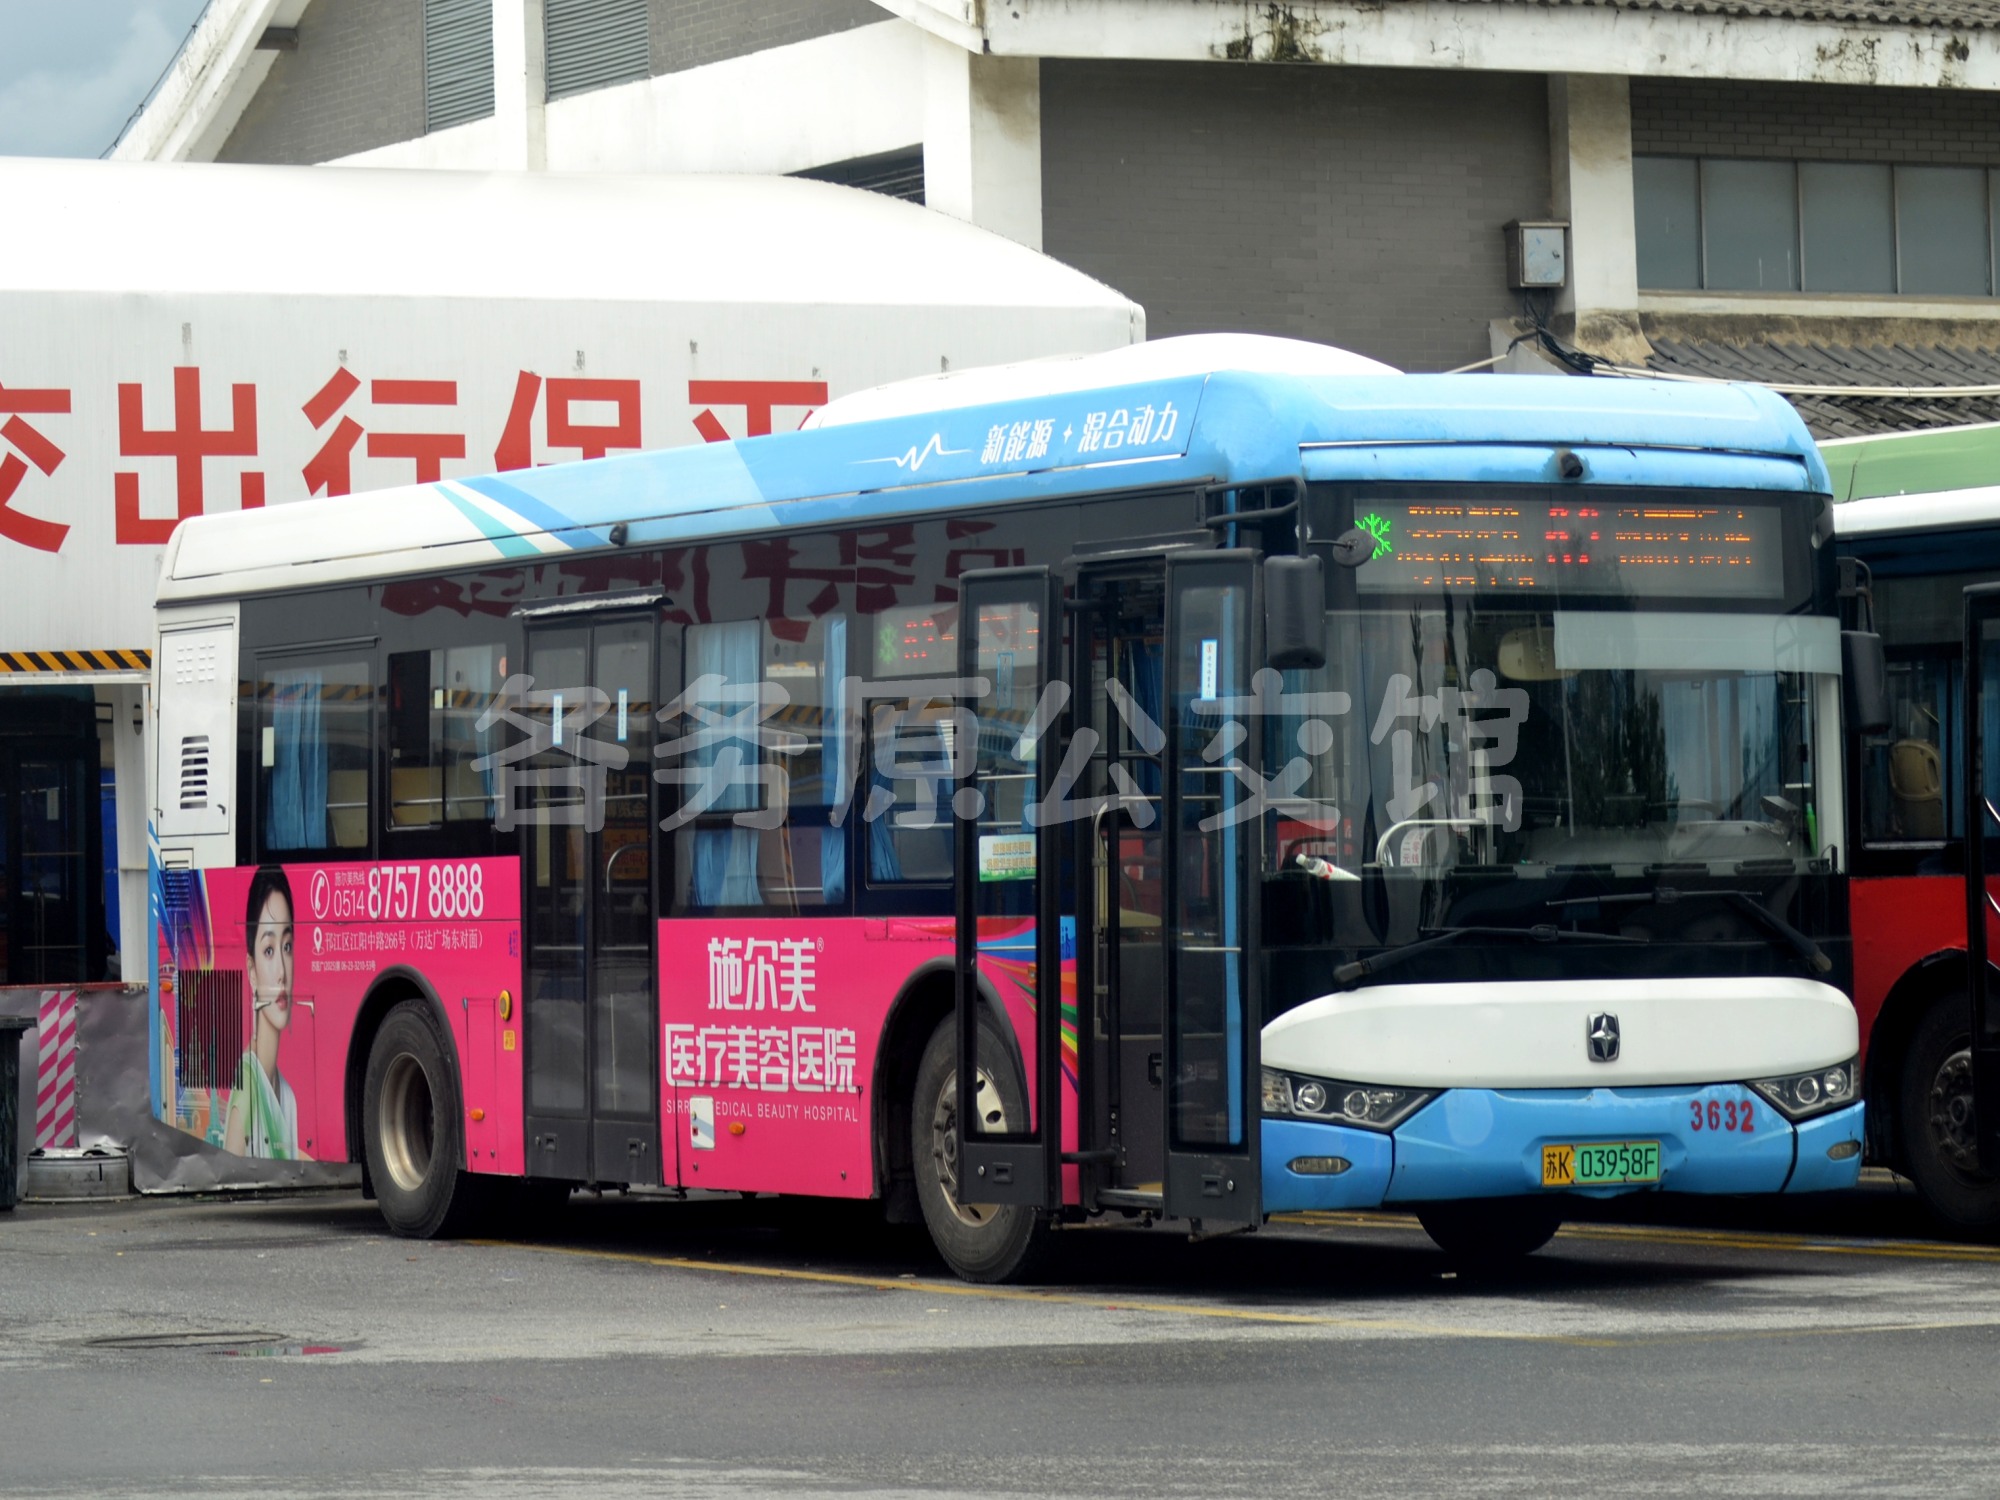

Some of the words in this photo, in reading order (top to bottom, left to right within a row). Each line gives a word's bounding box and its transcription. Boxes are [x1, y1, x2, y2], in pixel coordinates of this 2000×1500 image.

[980, 418, 1055, 465] 新能源
[1077, 401, 1178, 453] 混合动力
[334, 871, 366, 887] 施尔美热线
[334, 890, 365, 917] 0514
[368, 866, 421, 919] 8757
[428, 863, 484, 918] 8888
[708, 937, 816, 1012] 施尔美
[665, 1023, 857, 1093] 医疗美容医院
[715, 1101, 753, 1118] EDICAL
[757, 1103, 799, 1119] BEAUTY
[804, 1106, 858, 1122] HOSPITAL
[1690, 1100, 1754, 1132] 3632
